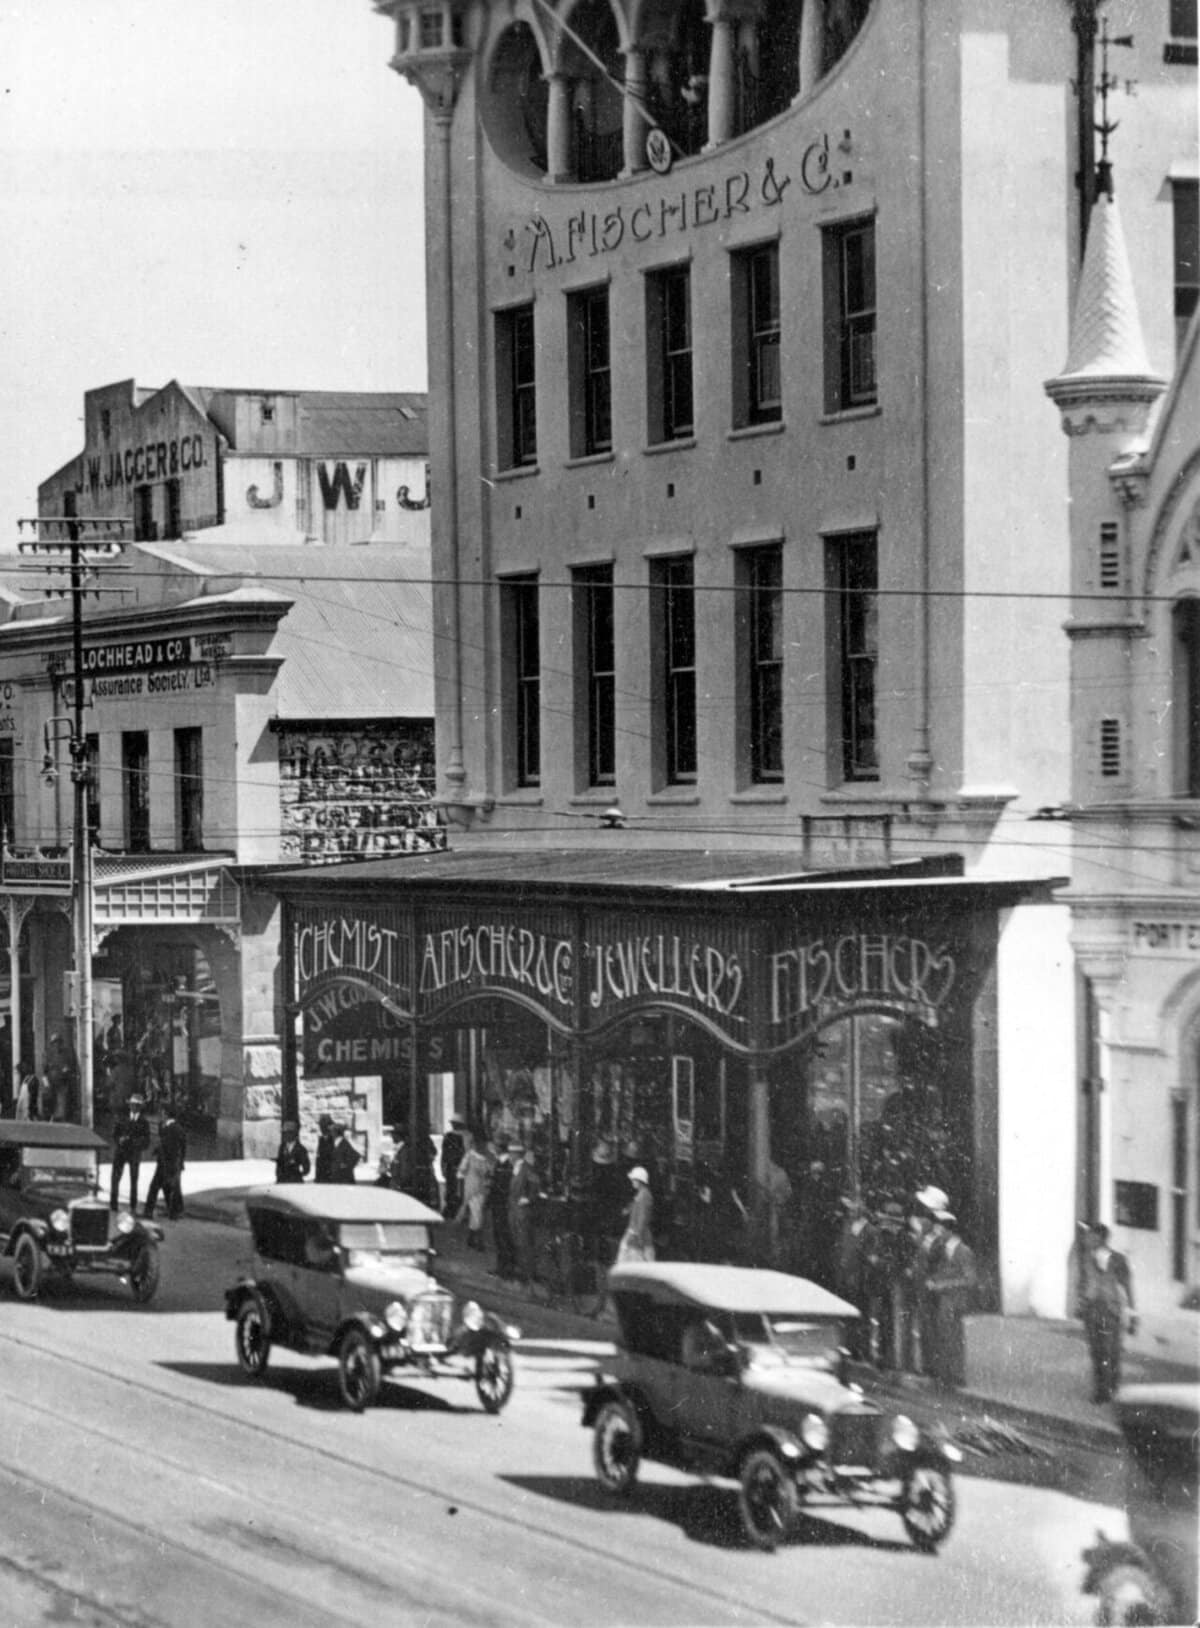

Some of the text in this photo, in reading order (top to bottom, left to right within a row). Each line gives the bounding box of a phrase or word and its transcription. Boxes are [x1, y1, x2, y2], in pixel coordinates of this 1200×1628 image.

[762, 157, 791, 206] &
[397, 463, 431, 511] J
[80, 641, 154, 671] LOCHHEAD
[156, 644, 164, 663] &
[91, 675, 143, 697] Assurance
[301, 917, 399, 986] CHEMIST
[590, 934, 743, 1016] JEWELLERS
[317, 1037, 444, 1063] CHEMISS
